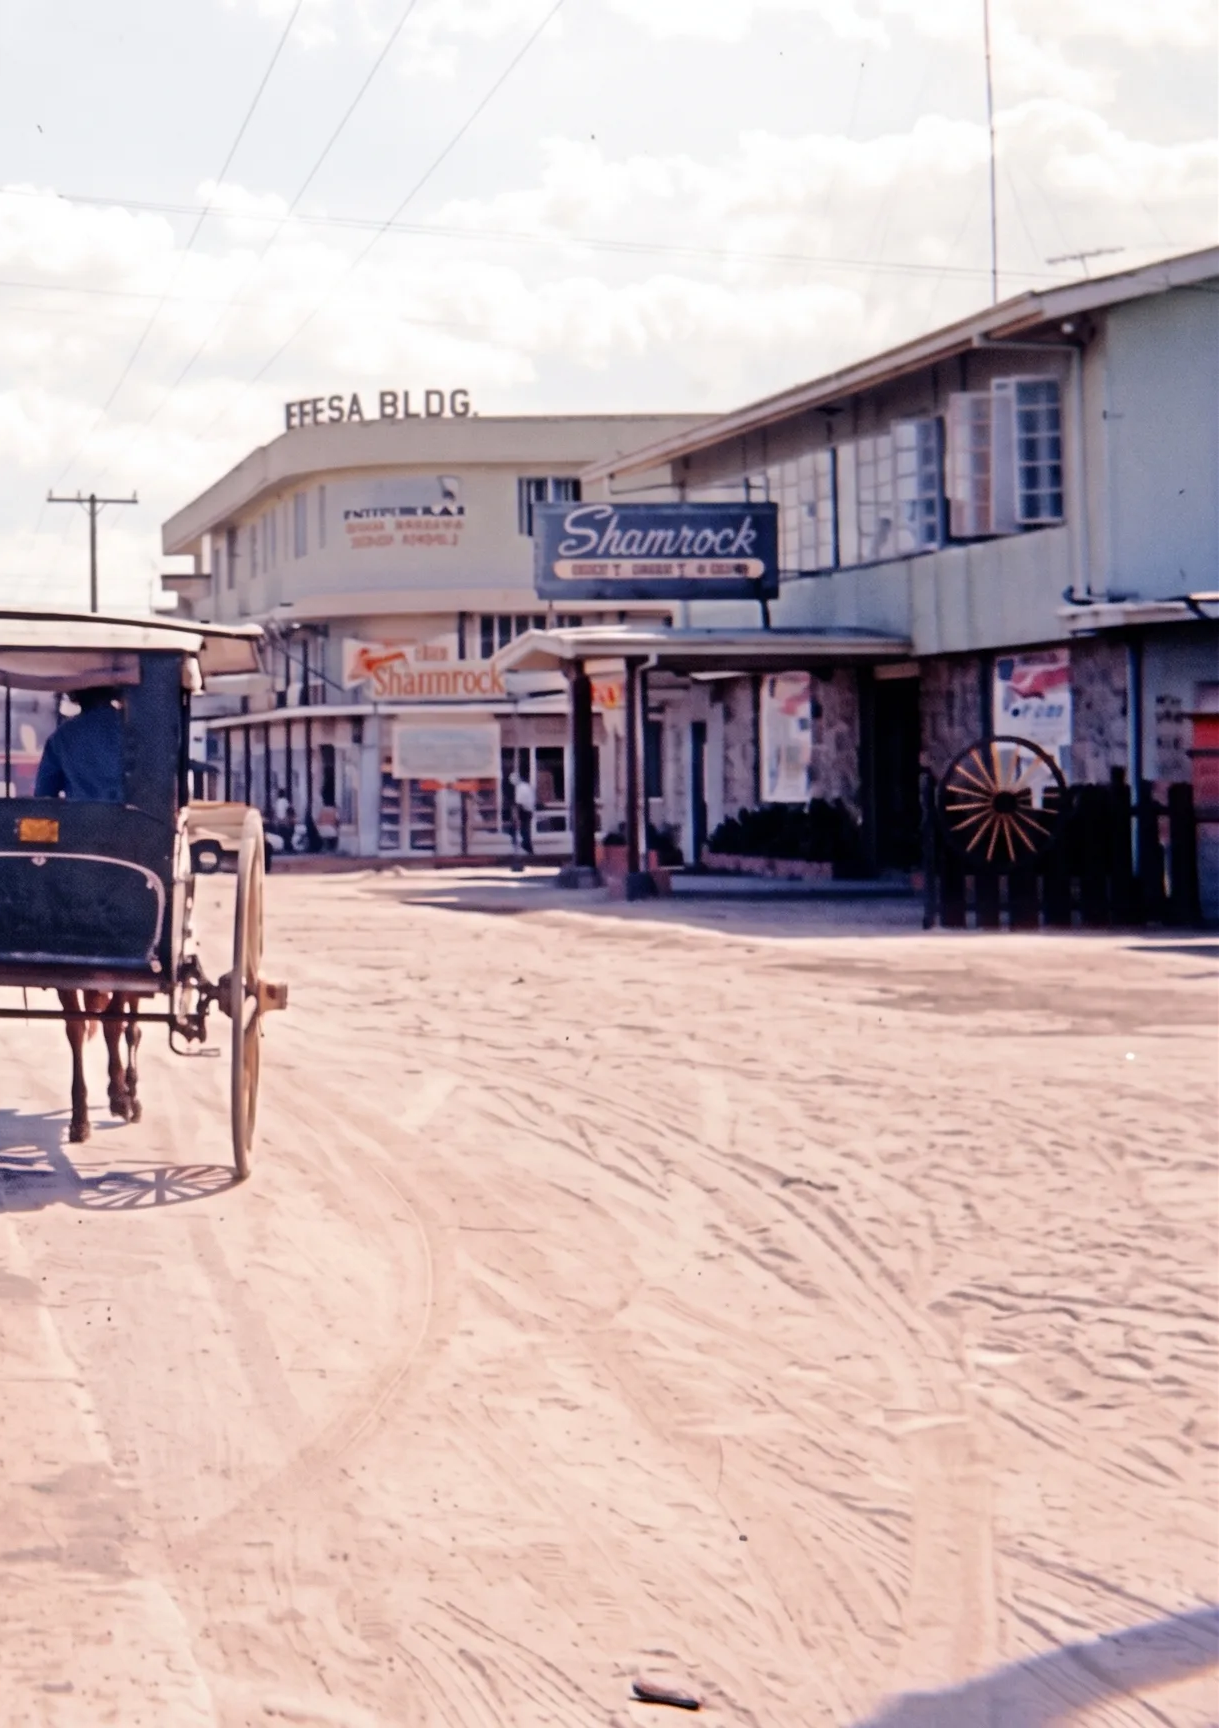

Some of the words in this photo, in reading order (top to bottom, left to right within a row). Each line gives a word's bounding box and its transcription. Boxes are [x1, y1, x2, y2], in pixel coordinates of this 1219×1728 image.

[380, 389, 479, 419] BLDG.
[558, 505, 757, 556] Shamrock
[373, 663, 505, 696] Shamrock
